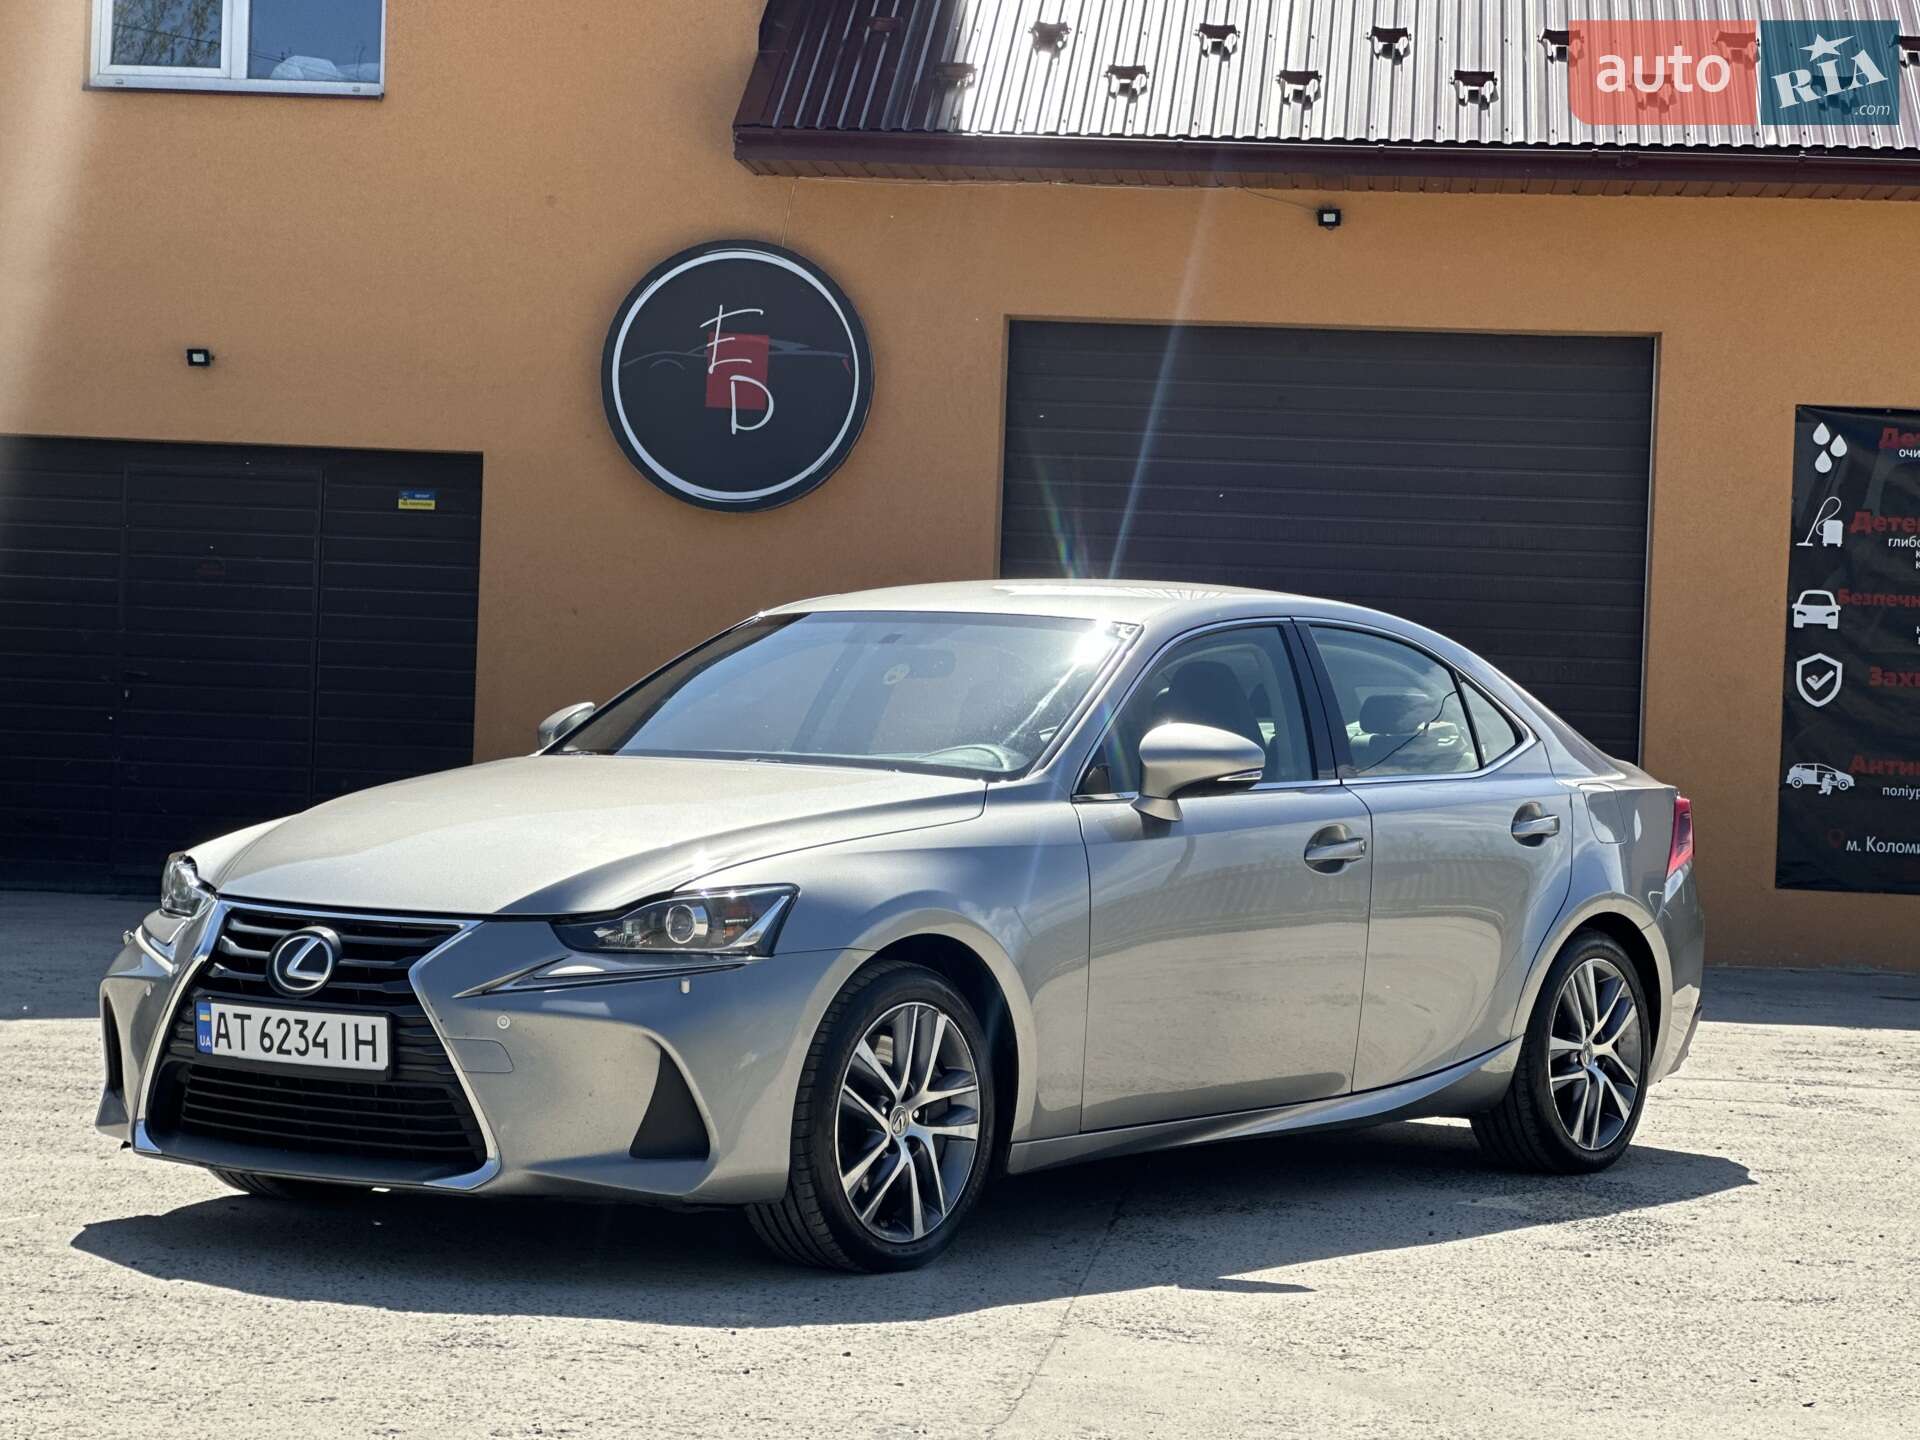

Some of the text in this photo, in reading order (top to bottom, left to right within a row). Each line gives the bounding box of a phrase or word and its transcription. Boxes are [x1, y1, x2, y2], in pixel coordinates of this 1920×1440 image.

[200, 1035, 212, 1048] UA
[214, 1011, 377, 1063] AT 6234 IH
